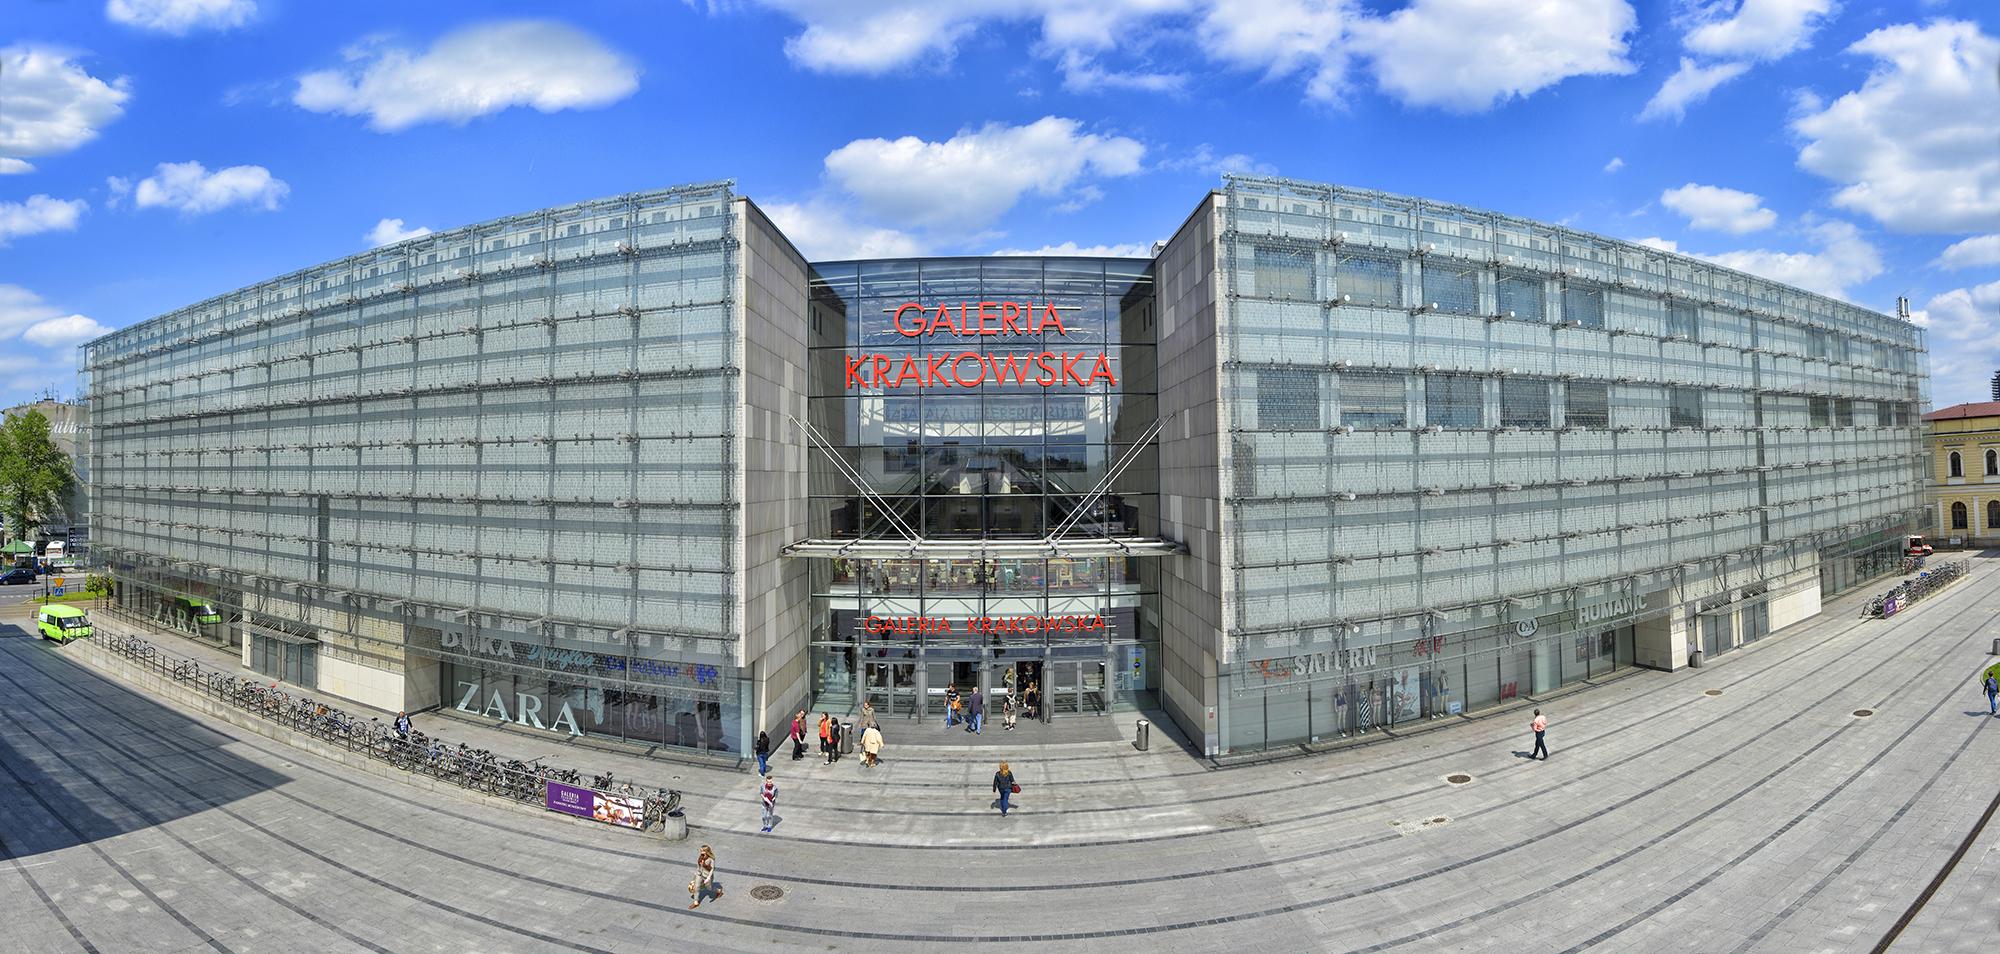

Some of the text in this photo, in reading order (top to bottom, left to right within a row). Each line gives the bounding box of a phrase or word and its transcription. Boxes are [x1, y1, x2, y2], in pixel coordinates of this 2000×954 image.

[894, 301, 1066, 337] GALERIA
[845, 352, 1118, 388] KRAKOWSKA
[153, 601, 202, 637] ZARA
[864, 614, 1105, 635] GALERIA KRAKOWSKA
[1578, 594, 1647, 624] HUMANIC
[441, 629, 516, 659] DUKA
[527, 643, 595, 671] Duglas
[1293, 645, 1377, 676] SATURN
[456, 681, 584, 736] ZARA
